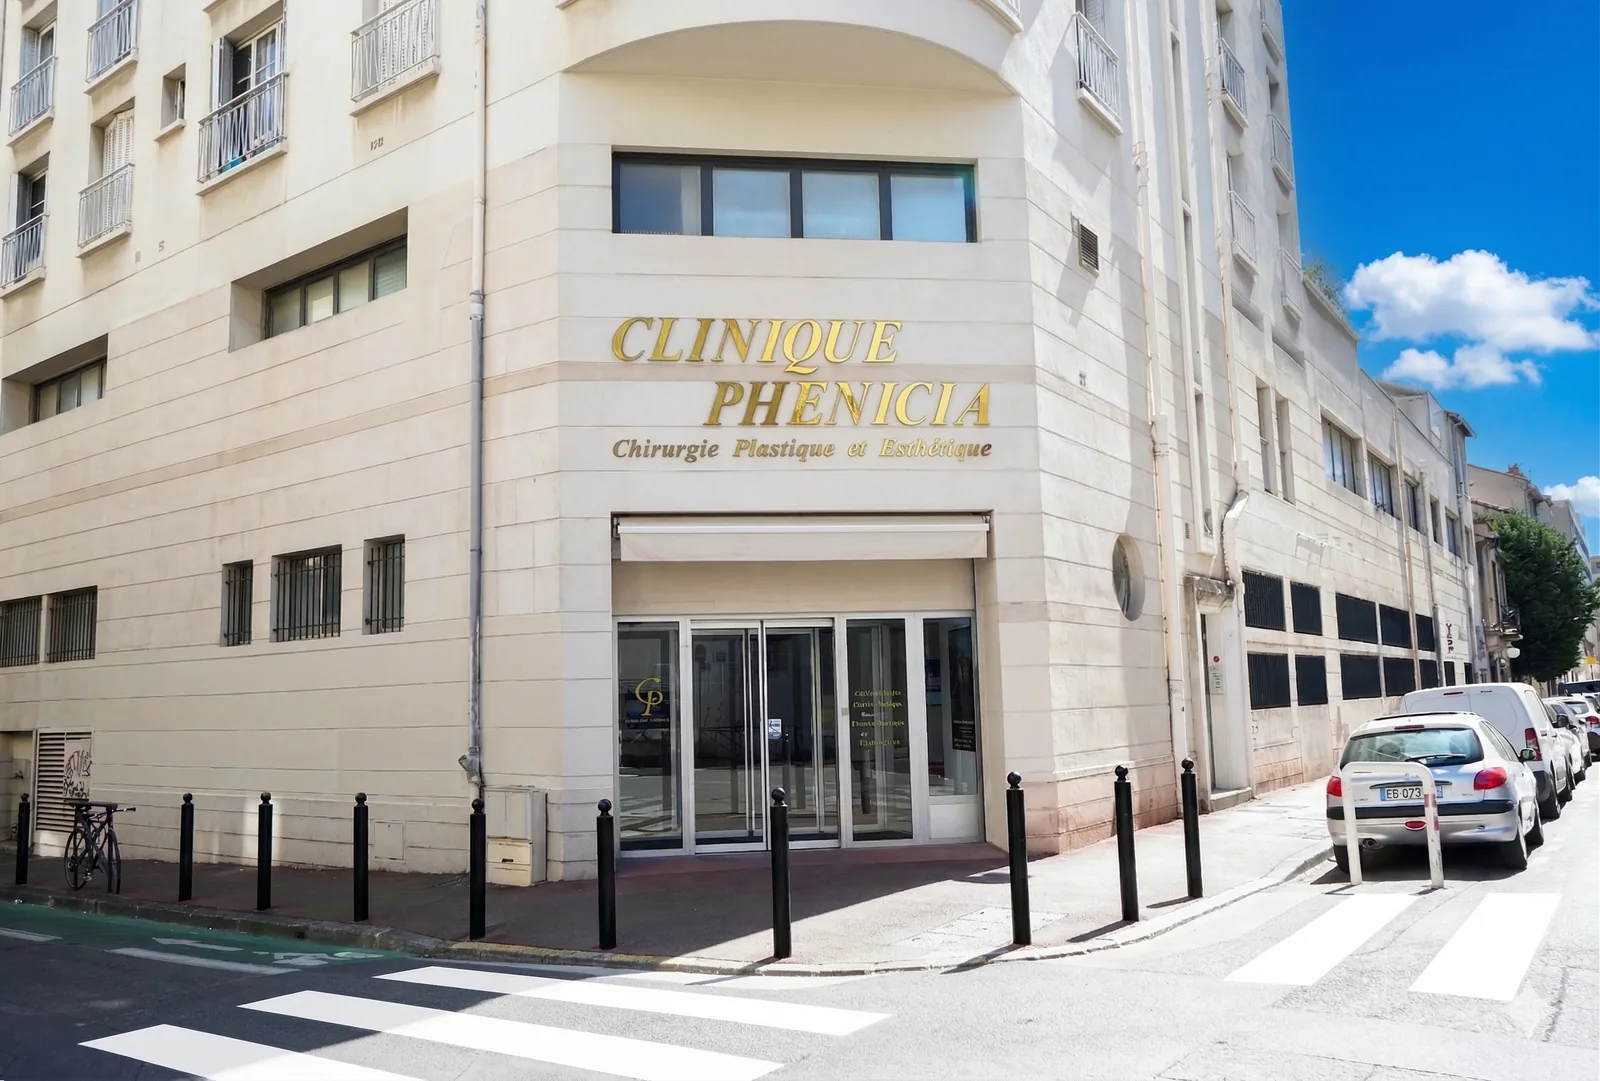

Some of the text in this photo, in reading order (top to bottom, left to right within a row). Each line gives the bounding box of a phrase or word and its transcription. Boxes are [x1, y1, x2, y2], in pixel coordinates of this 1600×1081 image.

[611, 316, 903, 375] CLINIQUE
[702, 381, 991, 426] PHENICIA
[612, 437, 992, 463] Chirurgie Plastique et Esthétique
